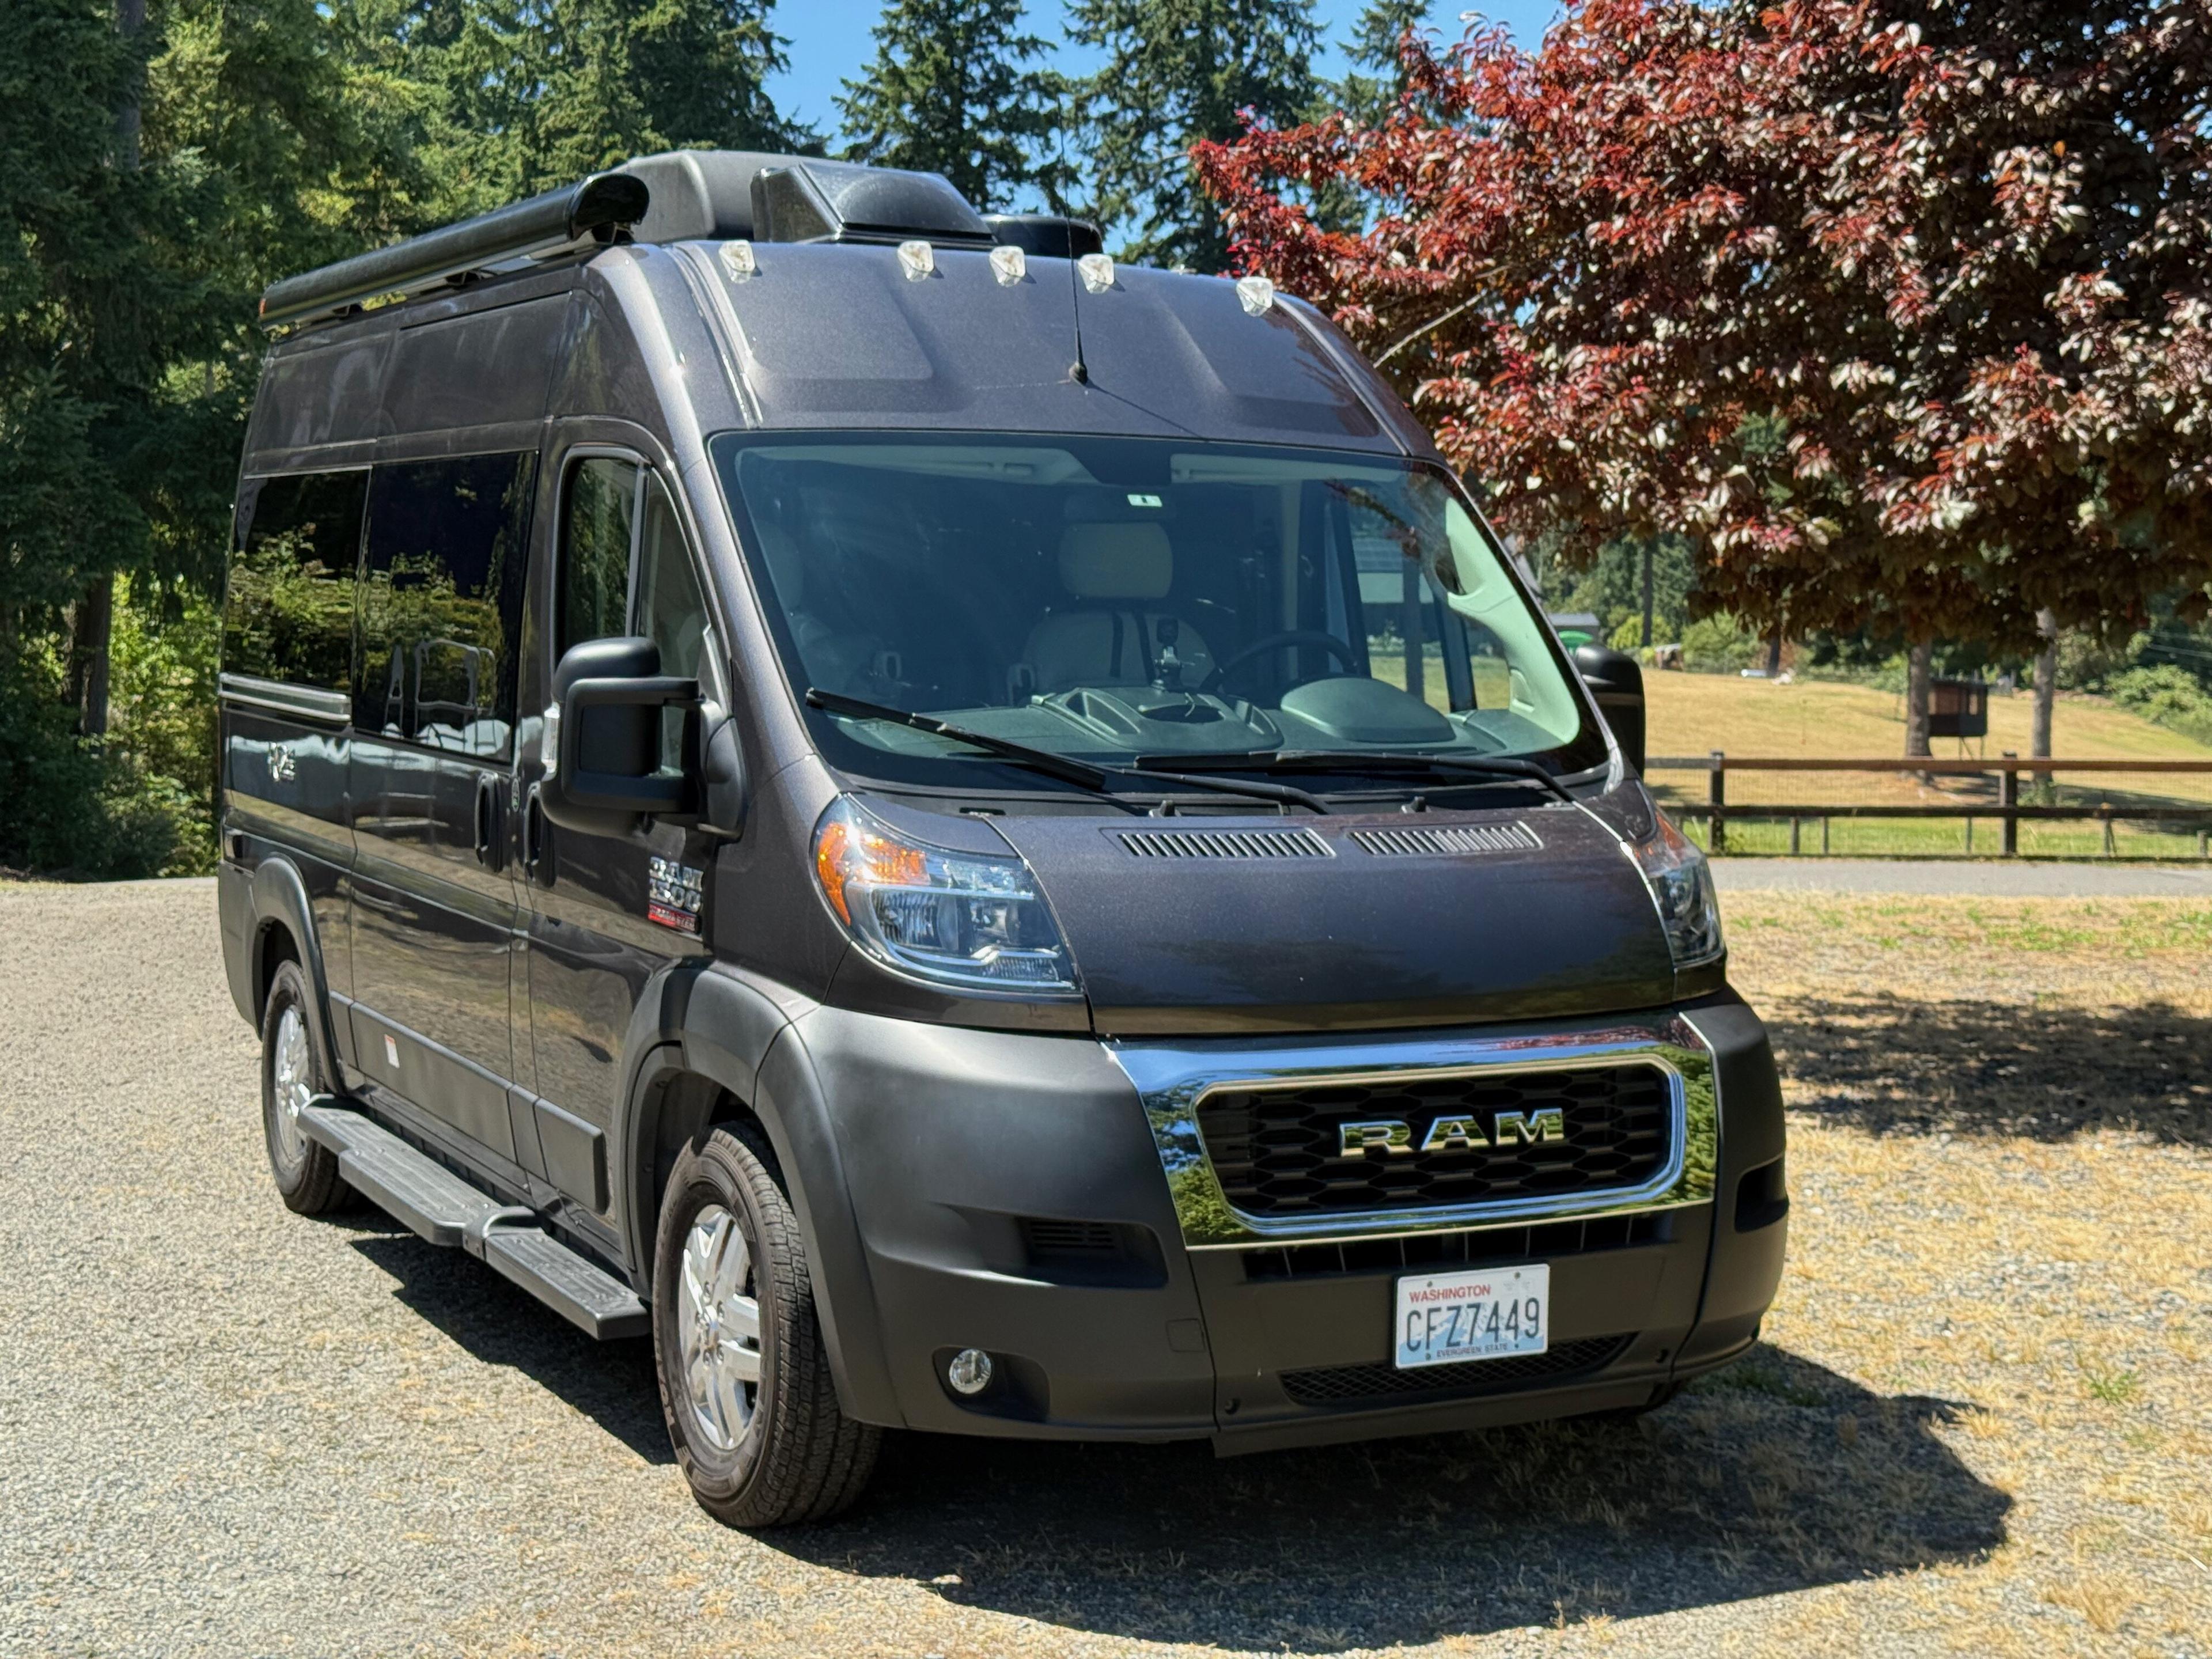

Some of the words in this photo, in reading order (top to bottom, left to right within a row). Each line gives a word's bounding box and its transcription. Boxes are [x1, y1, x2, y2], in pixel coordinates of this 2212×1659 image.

[1339, 1107, 1565, 1157] RAM
[1409, 1284, 1491, 1303] WASHINGTON
[1406, 1297, 1540, 1352] CFZ7449
[1436, 1346, 1482, 1358] EVERGREEN
[1484, 1342, 1508, 1353] STATE
